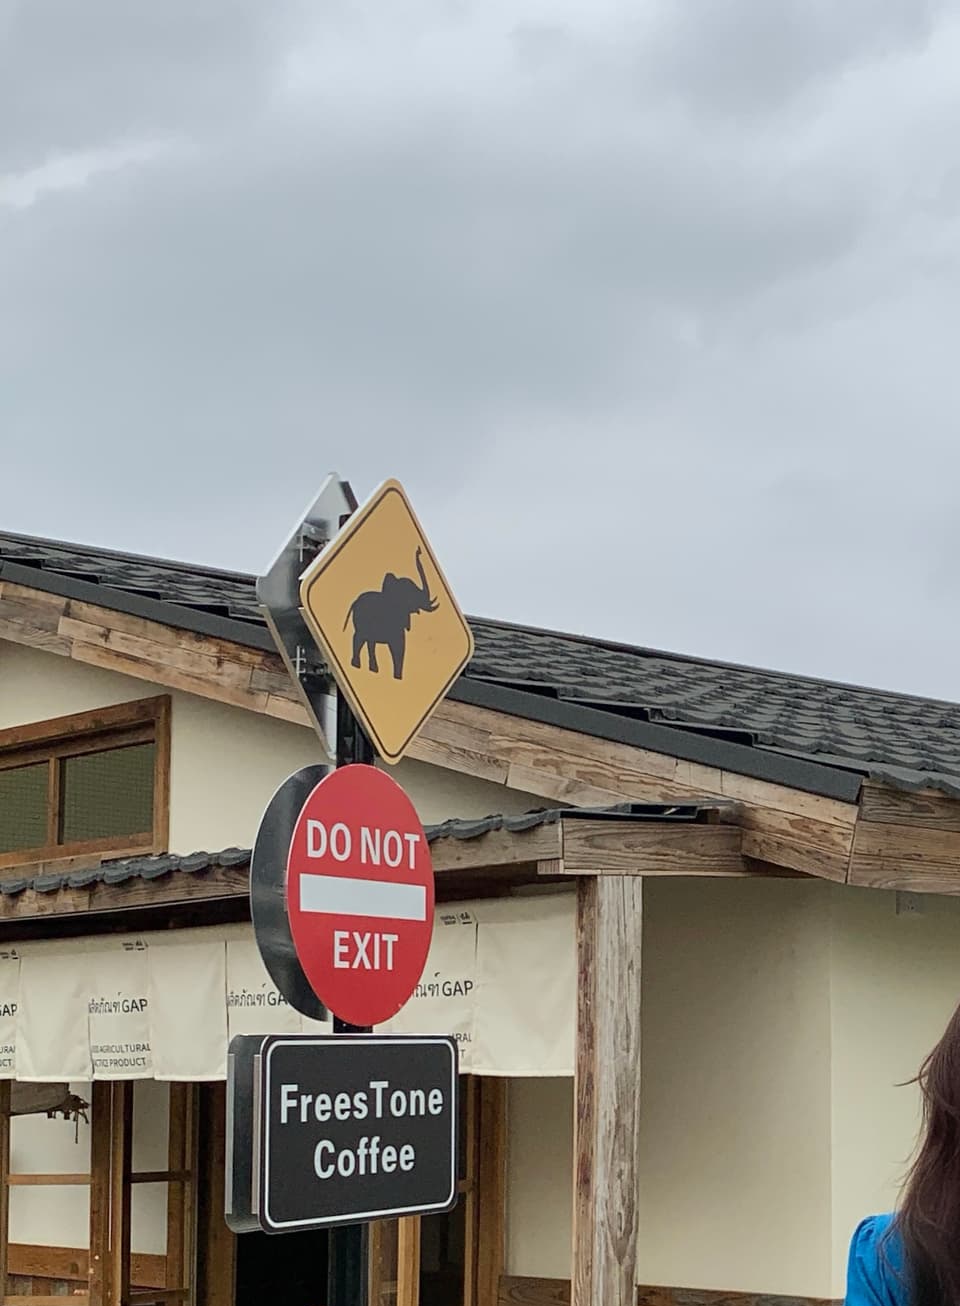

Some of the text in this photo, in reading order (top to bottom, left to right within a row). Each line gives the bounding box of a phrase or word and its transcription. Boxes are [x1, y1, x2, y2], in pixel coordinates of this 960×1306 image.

[306, 819, 420, 870] DO NOT
[333, 930, 399, 971] EXIT
[442, 979, 474, 997] GAP
[122, 998, 148, 1013] GAP
[267, 991, 288, 1006] GA
[99, 1043, 151, 1053] AGRICULTURAL
[109, 1057, 146, 1067] PRODUCT
[280, 1080, 443, 1124] FreesTone
[313, 1135, 416, 1180] Coffee
